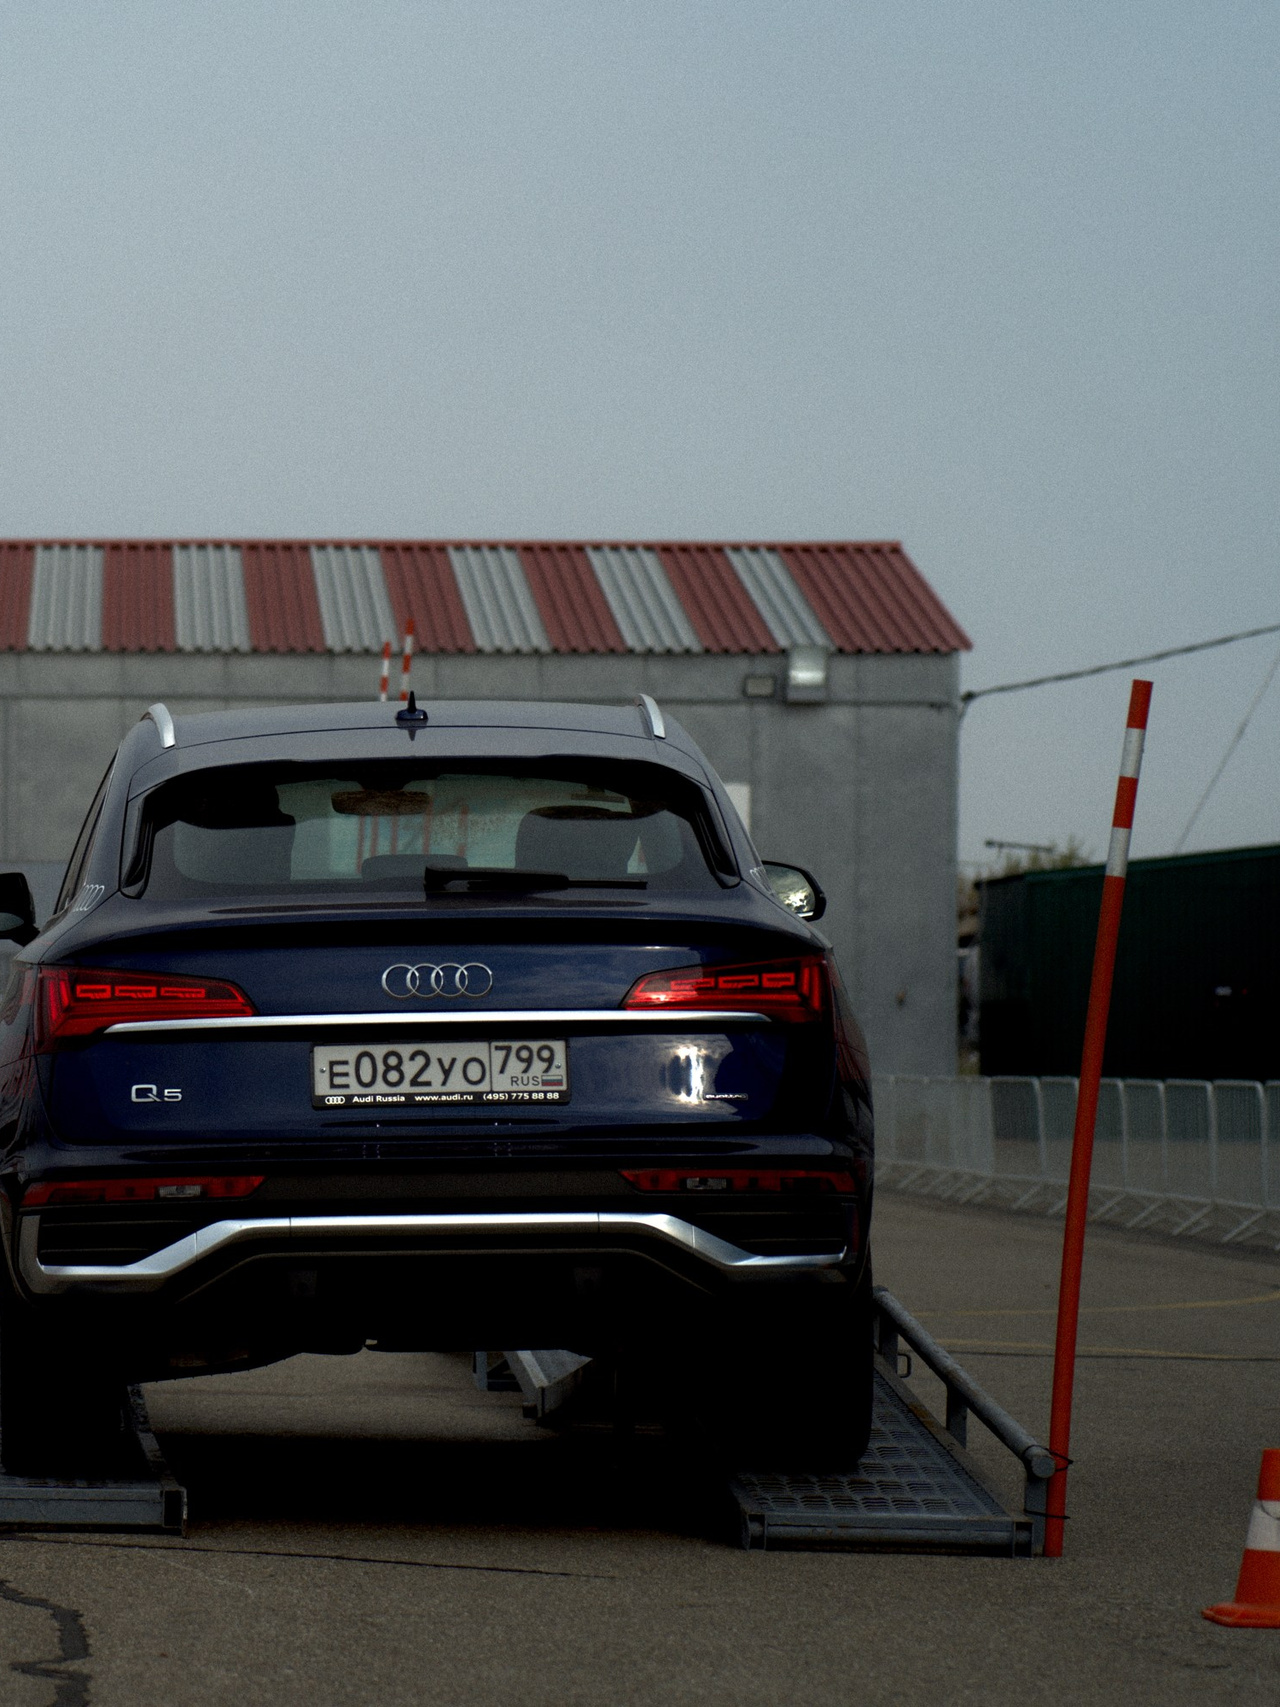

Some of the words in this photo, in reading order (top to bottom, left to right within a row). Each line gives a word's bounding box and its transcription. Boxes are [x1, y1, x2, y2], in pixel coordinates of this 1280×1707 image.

[494, 1044, 555, 1074] 799
[510, 1075, 540, 1087] RUS
[131, 1084, 182, 1102] Q5
[352, 1095, 374, 1103] Audi
[376, 1094, 406, 1103] Russia
[414, 1093, 474, 1102] www.audi.ru
[482, 1092, 509, 1101] (495)
[511, 1092, 530, 1100] 775
[531, 1092, 545, 1100] 88
[546, 1091, 560, 1100] 88
